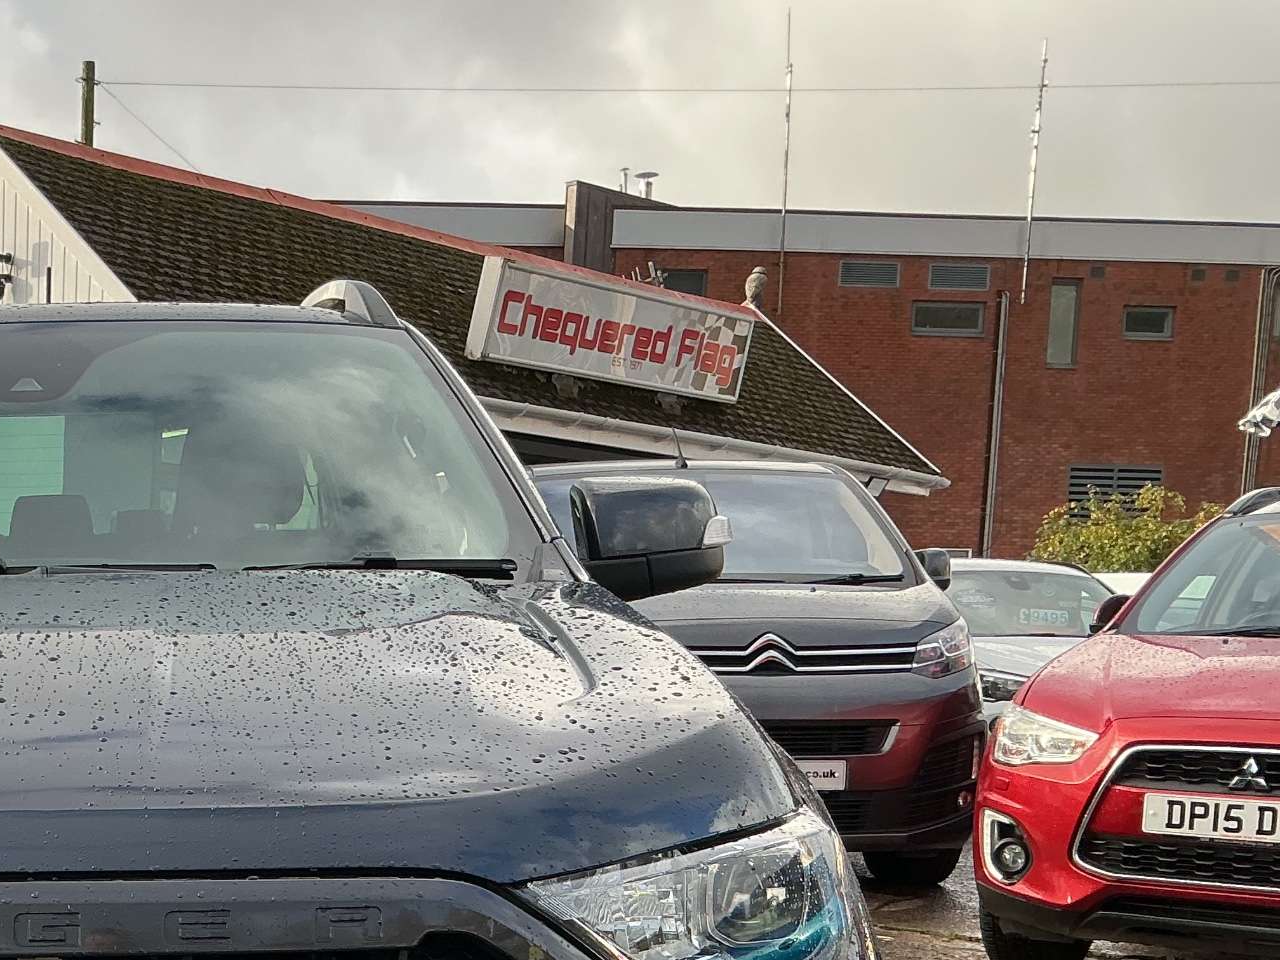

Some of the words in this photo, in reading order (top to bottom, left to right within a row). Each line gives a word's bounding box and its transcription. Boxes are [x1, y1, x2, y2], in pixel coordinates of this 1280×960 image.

[497, 289, 673, 364] Chequered
[675, 328, 738, 389] Flag
[1165, 800, 1245, 833] DP15
